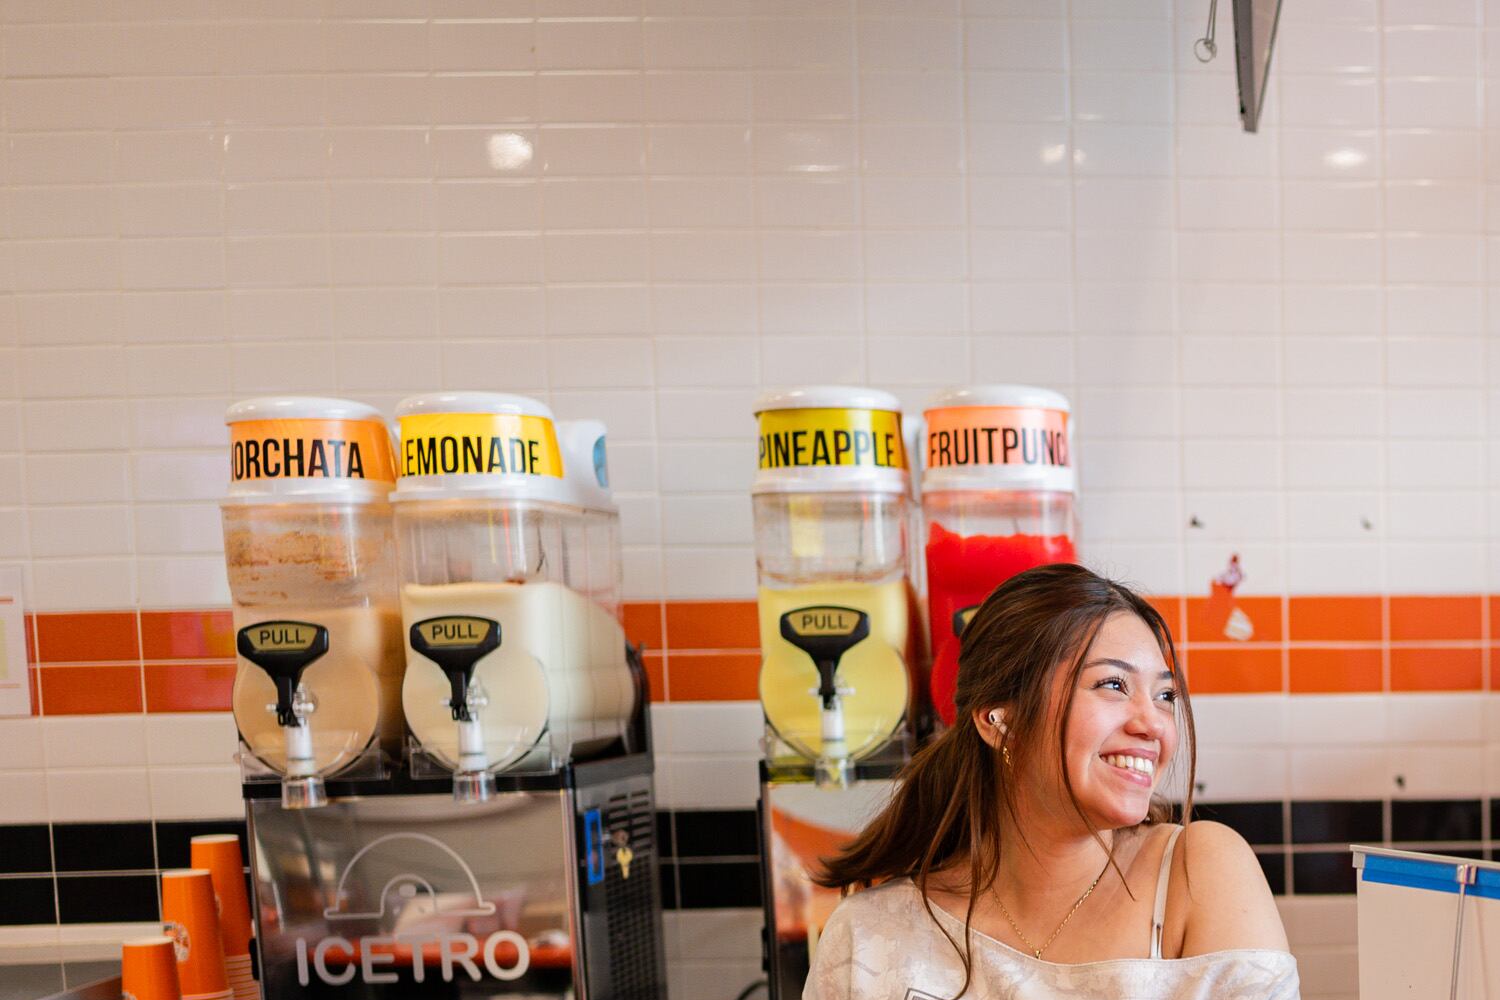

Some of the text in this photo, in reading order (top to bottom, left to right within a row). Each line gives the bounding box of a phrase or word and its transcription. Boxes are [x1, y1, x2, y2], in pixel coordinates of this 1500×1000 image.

[759, 430, 896, 469] PINEAPPLE
[929, 428, 1068, 467] FRUITPUNC
[432, 623, 479, 640] PULL
[802, 614, 848, 630] PULL
[259, 628, 306, 645] PULL
[296, 929, 530, 987] ICETRO
